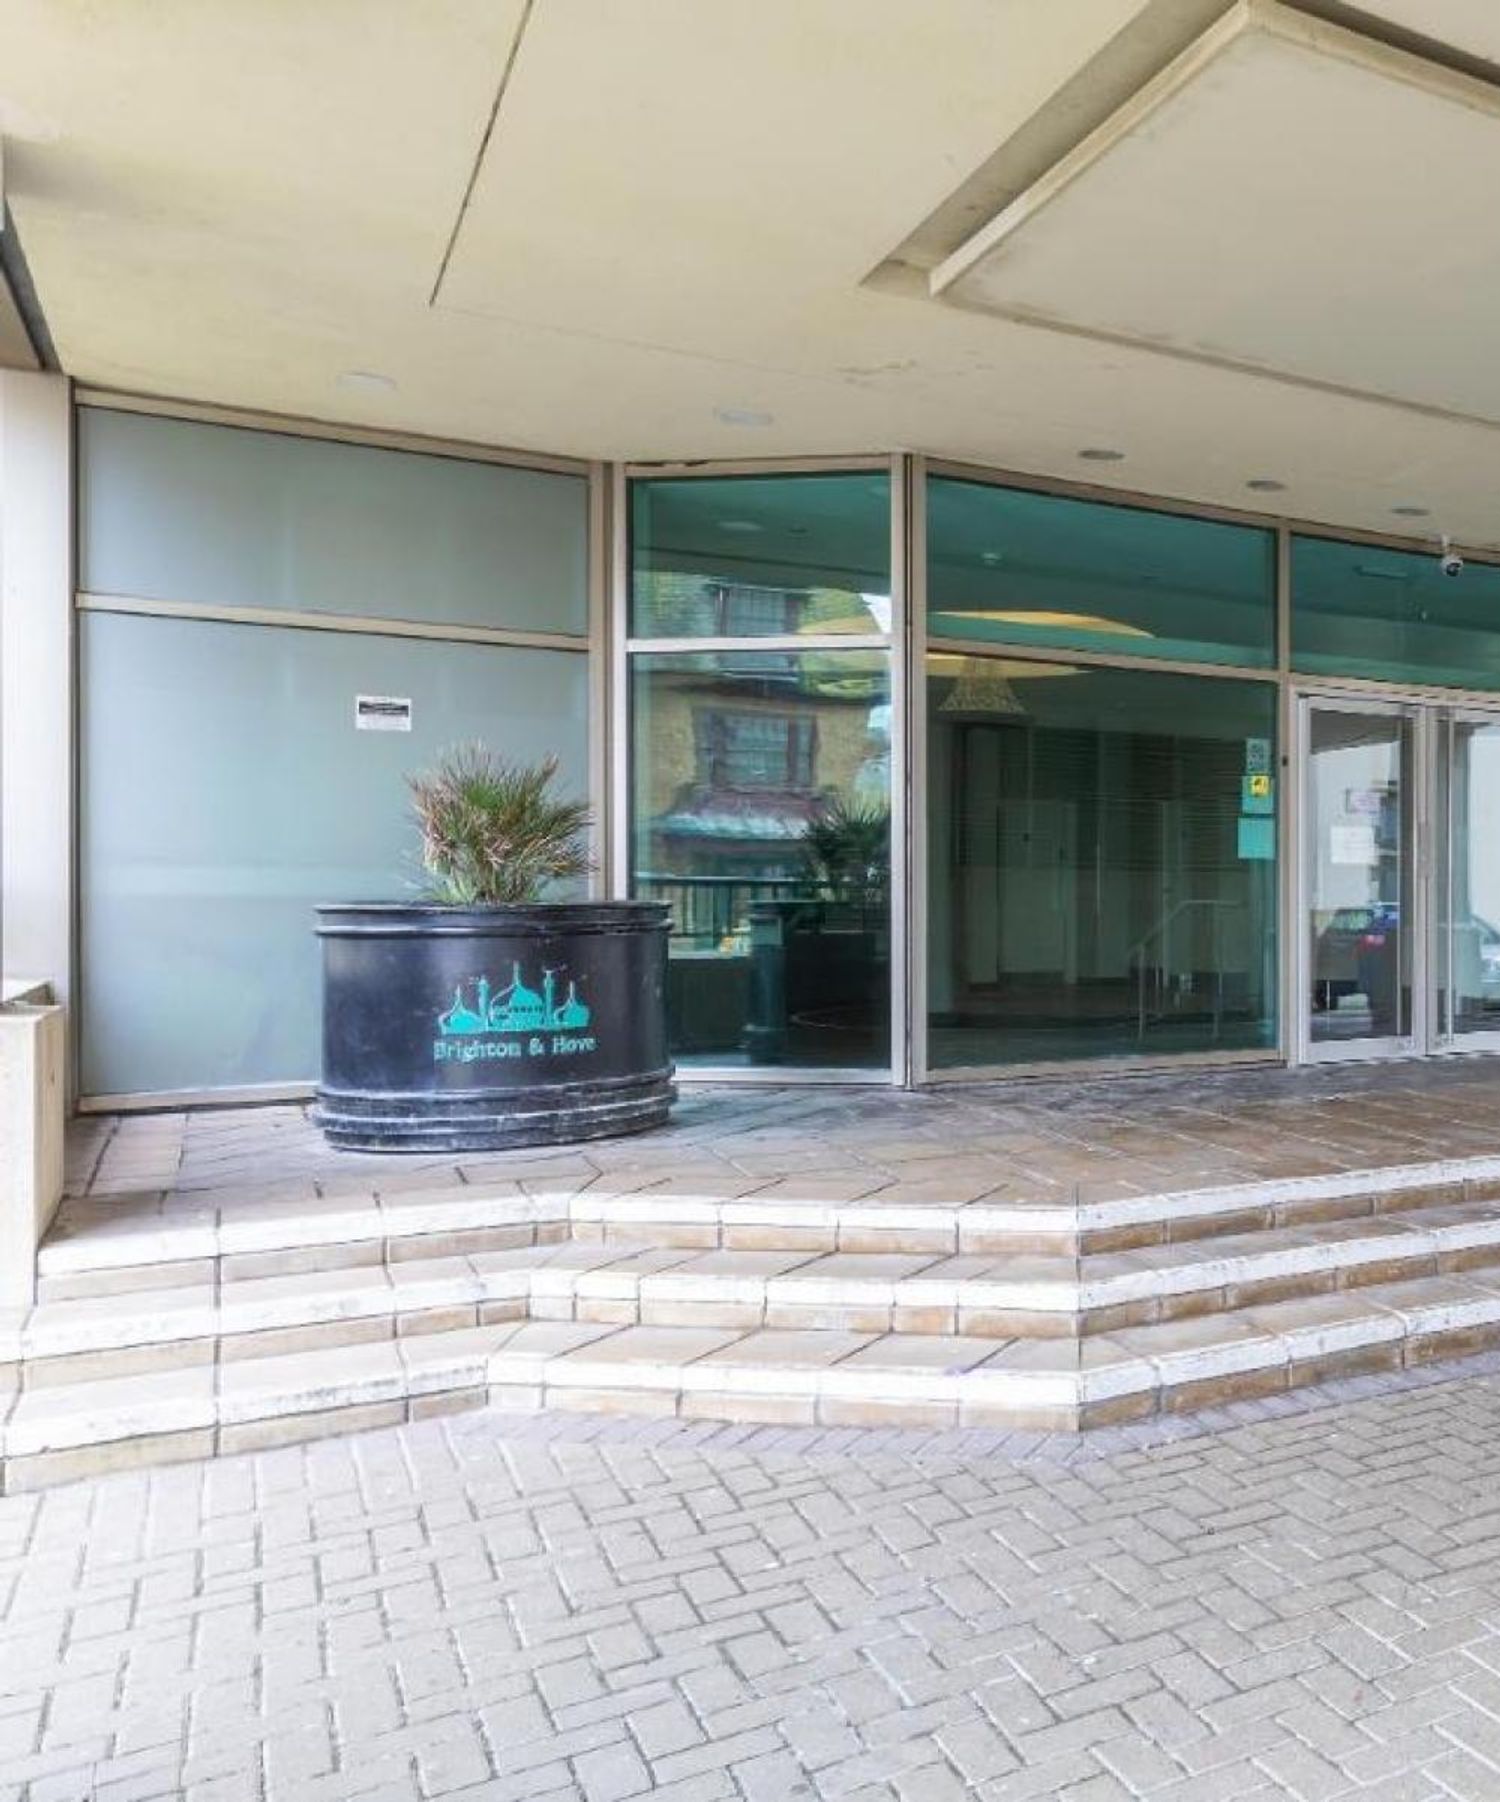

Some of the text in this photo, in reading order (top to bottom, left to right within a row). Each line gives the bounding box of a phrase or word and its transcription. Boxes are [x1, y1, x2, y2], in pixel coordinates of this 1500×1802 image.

[433, 1034, 596, 1063] Brighton & Hove
